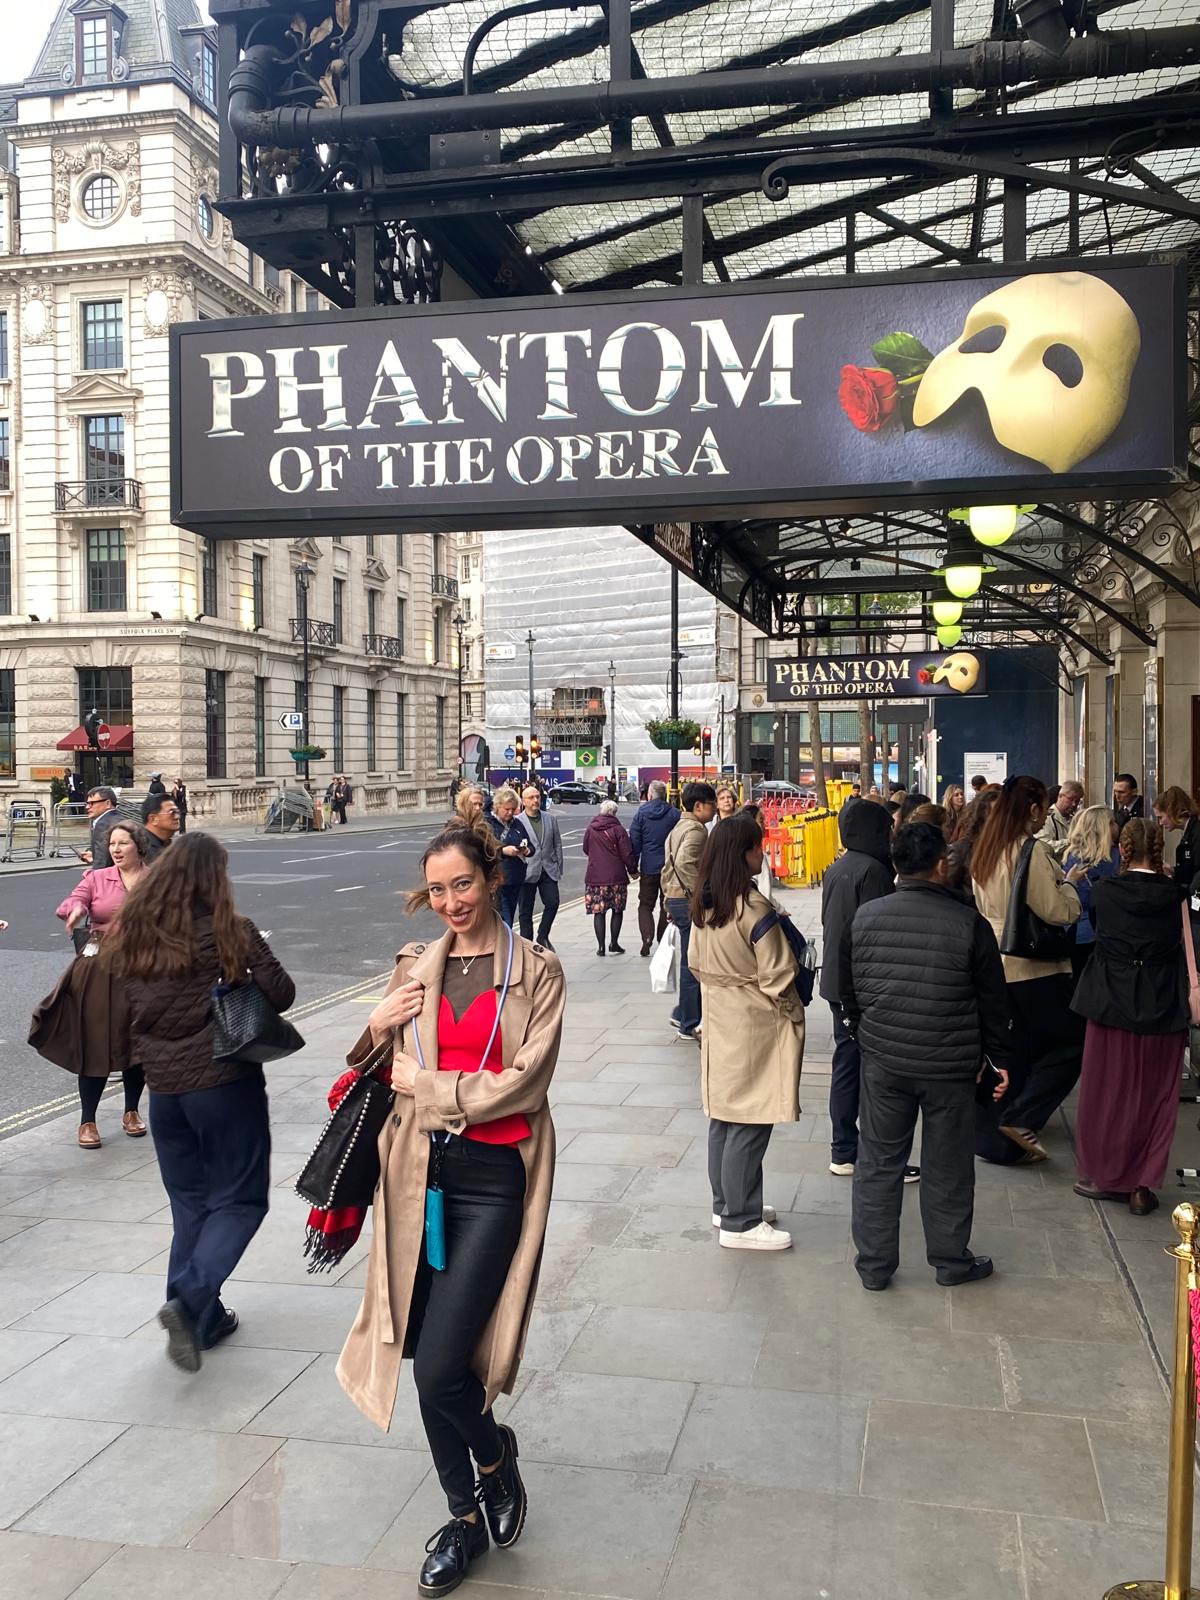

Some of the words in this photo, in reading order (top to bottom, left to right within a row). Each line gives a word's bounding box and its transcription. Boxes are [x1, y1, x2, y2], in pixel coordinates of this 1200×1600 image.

[200, 313, 805, 438] PHANTOM
[268, 444, 351, 494] OF
[364, 437, 496, 490] THE
[506, 426, 730, 486] OPERA
[120, 627, 145, 635] SUFFOLK
[147, 627, 164, 635] PLACE
[774, 659, 911, 684] PHANTOM
[790, 684, 809, 696] OF
[812, 683, 843, 695] THE
[842, 682, 895, 694] OPERA
[291, 715, 299, 724] P
